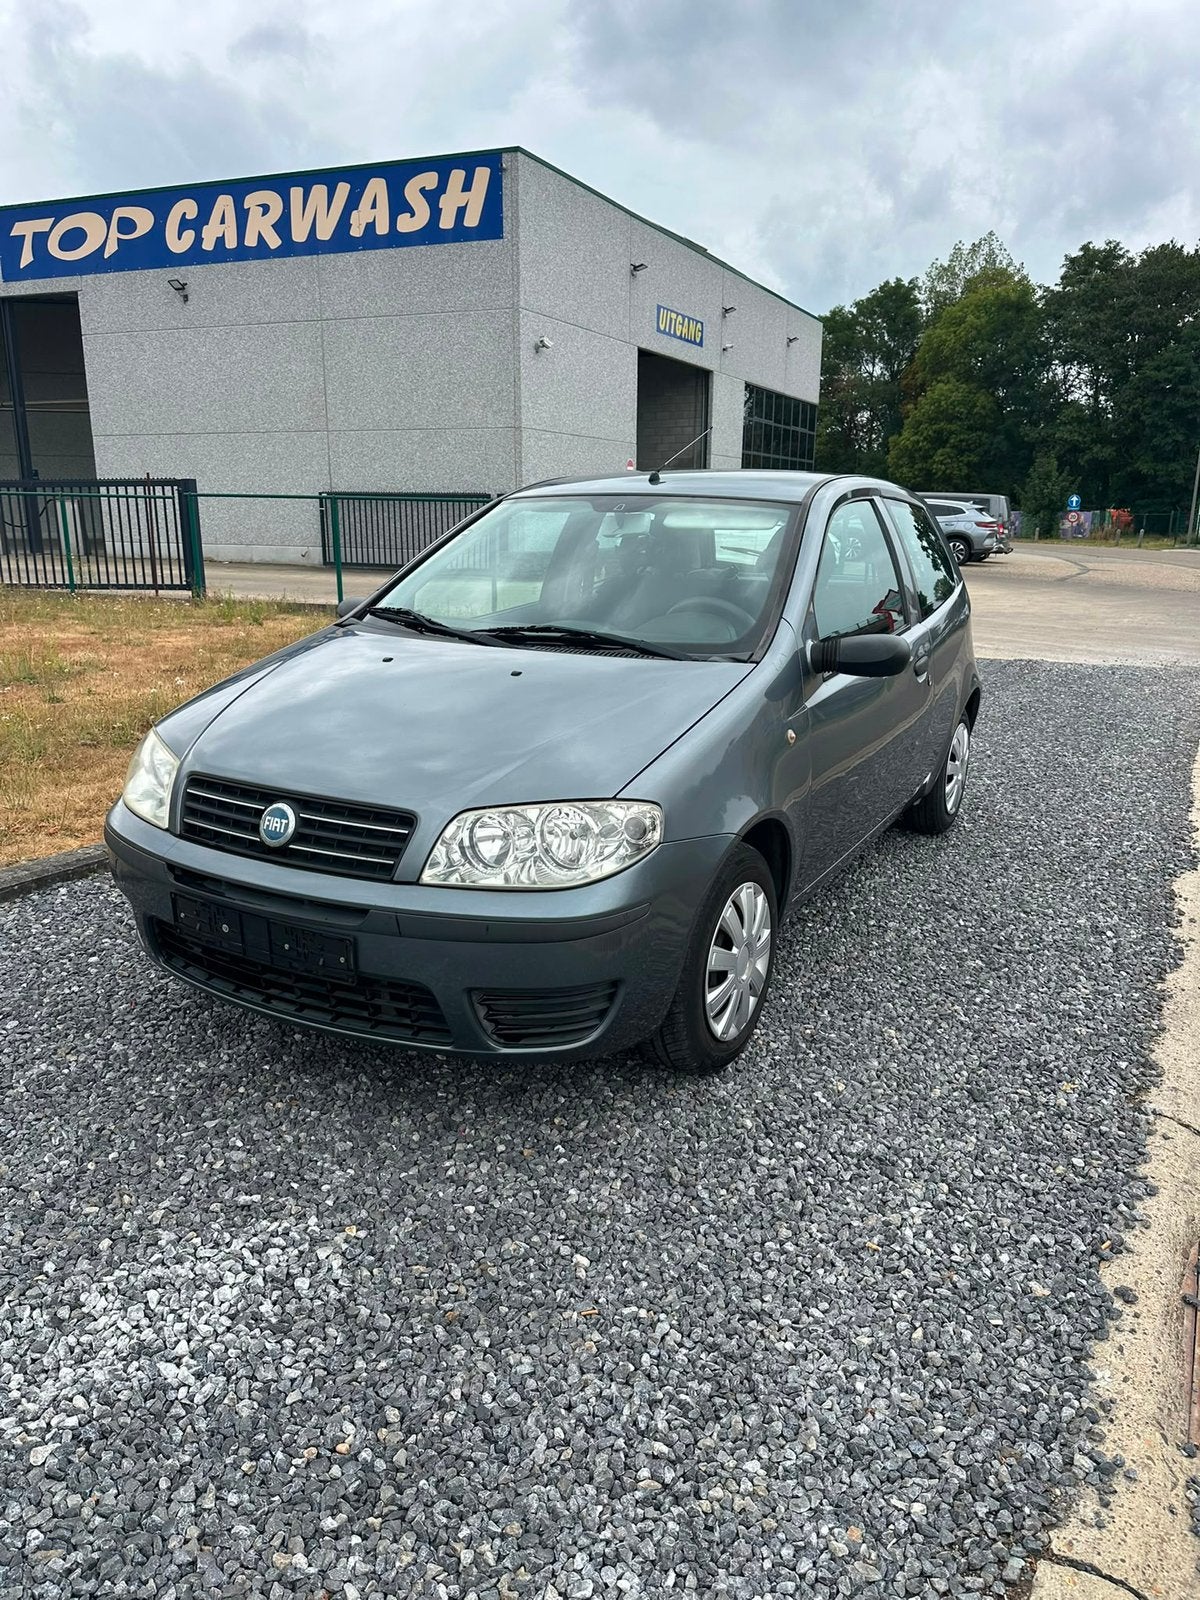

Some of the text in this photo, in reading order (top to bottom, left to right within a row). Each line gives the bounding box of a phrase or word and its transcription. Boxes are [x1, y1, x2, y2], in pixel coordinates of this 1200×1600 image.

[9, 166, 491, 269] TOP CARWASH
[659, 307, 702, 343] UITGANG
[264, 816, 288, 833] FIAT
